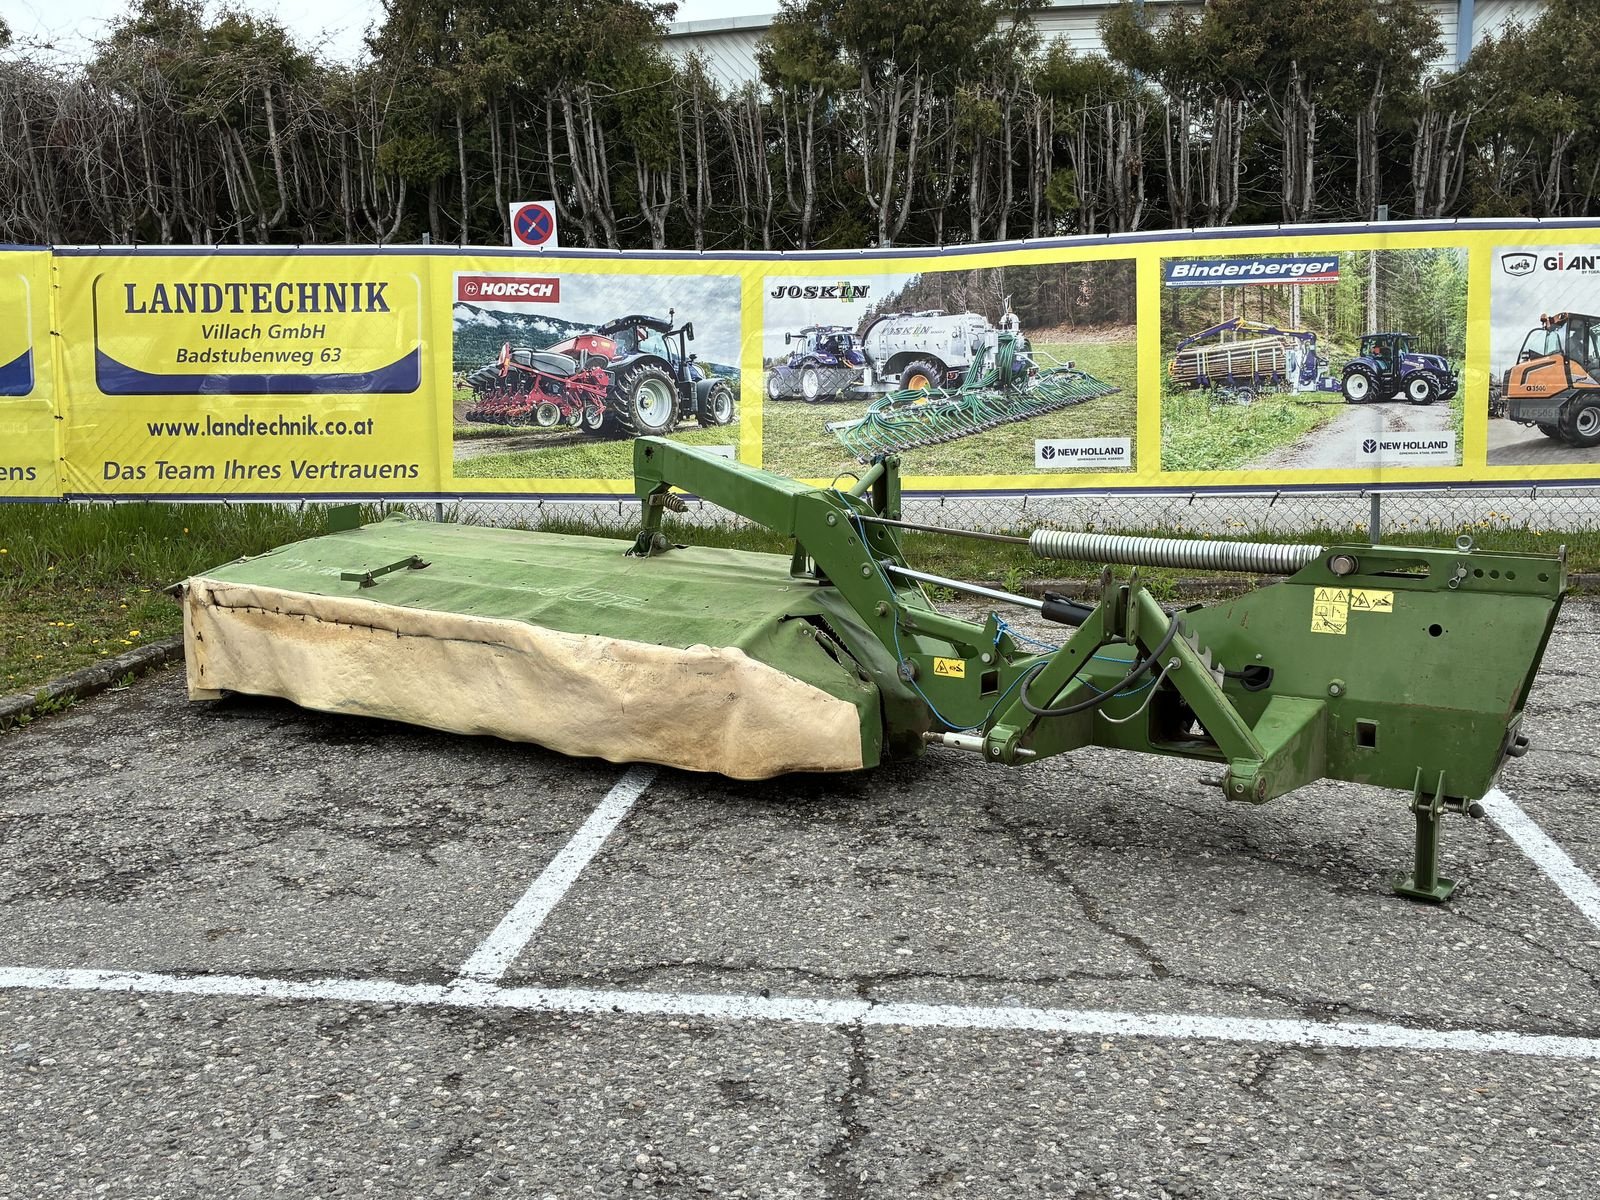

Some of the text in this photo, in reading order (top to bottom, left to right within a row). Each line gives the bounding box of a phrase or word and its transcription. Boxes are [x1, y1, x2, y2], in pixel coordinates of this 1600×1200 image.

[1170, 262, 1335, 278] Binderberger
[480, 282, 554, 297] HORSCH
[770, 284, 871, 300] JOSKIN
[123, 282, 391, 314] LANDTECHNIK
[201, 323, 326, 340] Villach GmbH
[176, 347, 342, 367] Badstubenweg 63
[146, 414, 374, 437] www.landtechnik.co.at
[1057, 447, 1124, 457] NEW HOLLAND
[1380, 440, 1449, 450] NEW HOLLAND
[103, 459, 420, 480] Das Team Ihres Vertrauens
